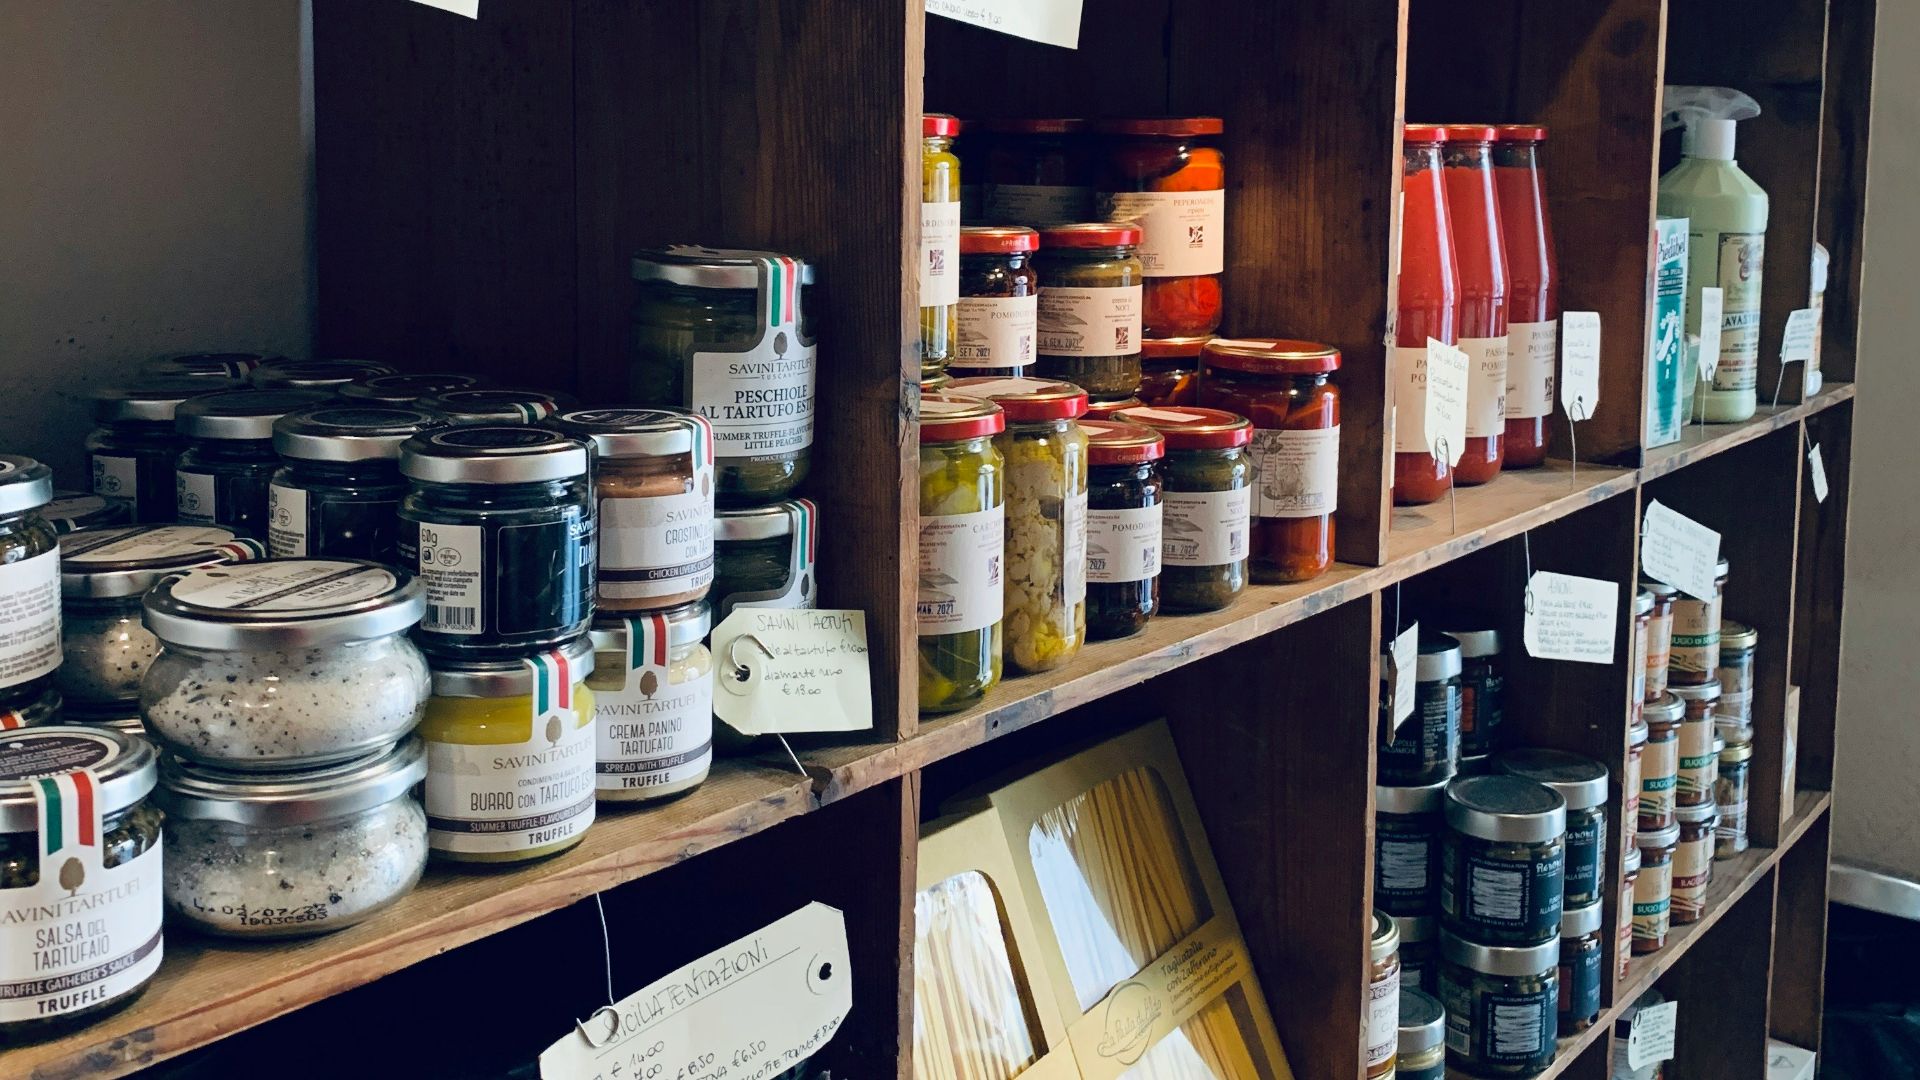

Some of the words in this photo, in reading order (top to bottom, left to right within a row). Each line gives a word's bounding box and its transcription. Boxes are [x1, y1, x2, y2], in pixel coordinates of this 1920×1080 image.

[728, 362, 775, 375] SAVINI
[734, 384, 808, 404] PESCHIOLE
[700, 405, 720, 419] AL
[723, 402, 794, 420] TARTUFO
[712, 432, 751, 441] SUMMER
[744, 440, 775, 449] LITTLE
[648, 568, 679, 579] CHICKEN
[936, 603, 954, 614] 2021
[609, 723, 646, 739] CREMA
[648, 717, 682, 737] PANINO
[620, 736, 674, 756] TARTUFATO
[492, 752, 547, 771] SAVINI
[605, 762, 636, 773] SPREAD
[637, 759, 657, 771] WITH
[658, 754, 686, 768] TRUFFLE
[622, 773, 671, 788] TRUFFLE
[470, 791, 514, 812] BURRO
[517, 795, 537, 810] CON
[539, 780, 581, 805] TARTUFO
[470, 822, 506, 833] SUMMER
[528, 823, 574, 845] TRUFFLE
[1, 903, 62, 925] AVINI
[64, 877, 141, 916] TARTUFI
[35, 922, 83, 949] SALSA
[87, 918, 107, 938] DEL
[33, 934, 110, 972] TARTUFAIO
[1160, 940, 1205, 977] Tagliatelle
[0, 982, 43, 998] TRUFFLE
[45, 963, 109, 992] GATHERER'S
[109, 953, 136, 971] SAUCE
[37, 985, 107, 1015] TRUFFLE
